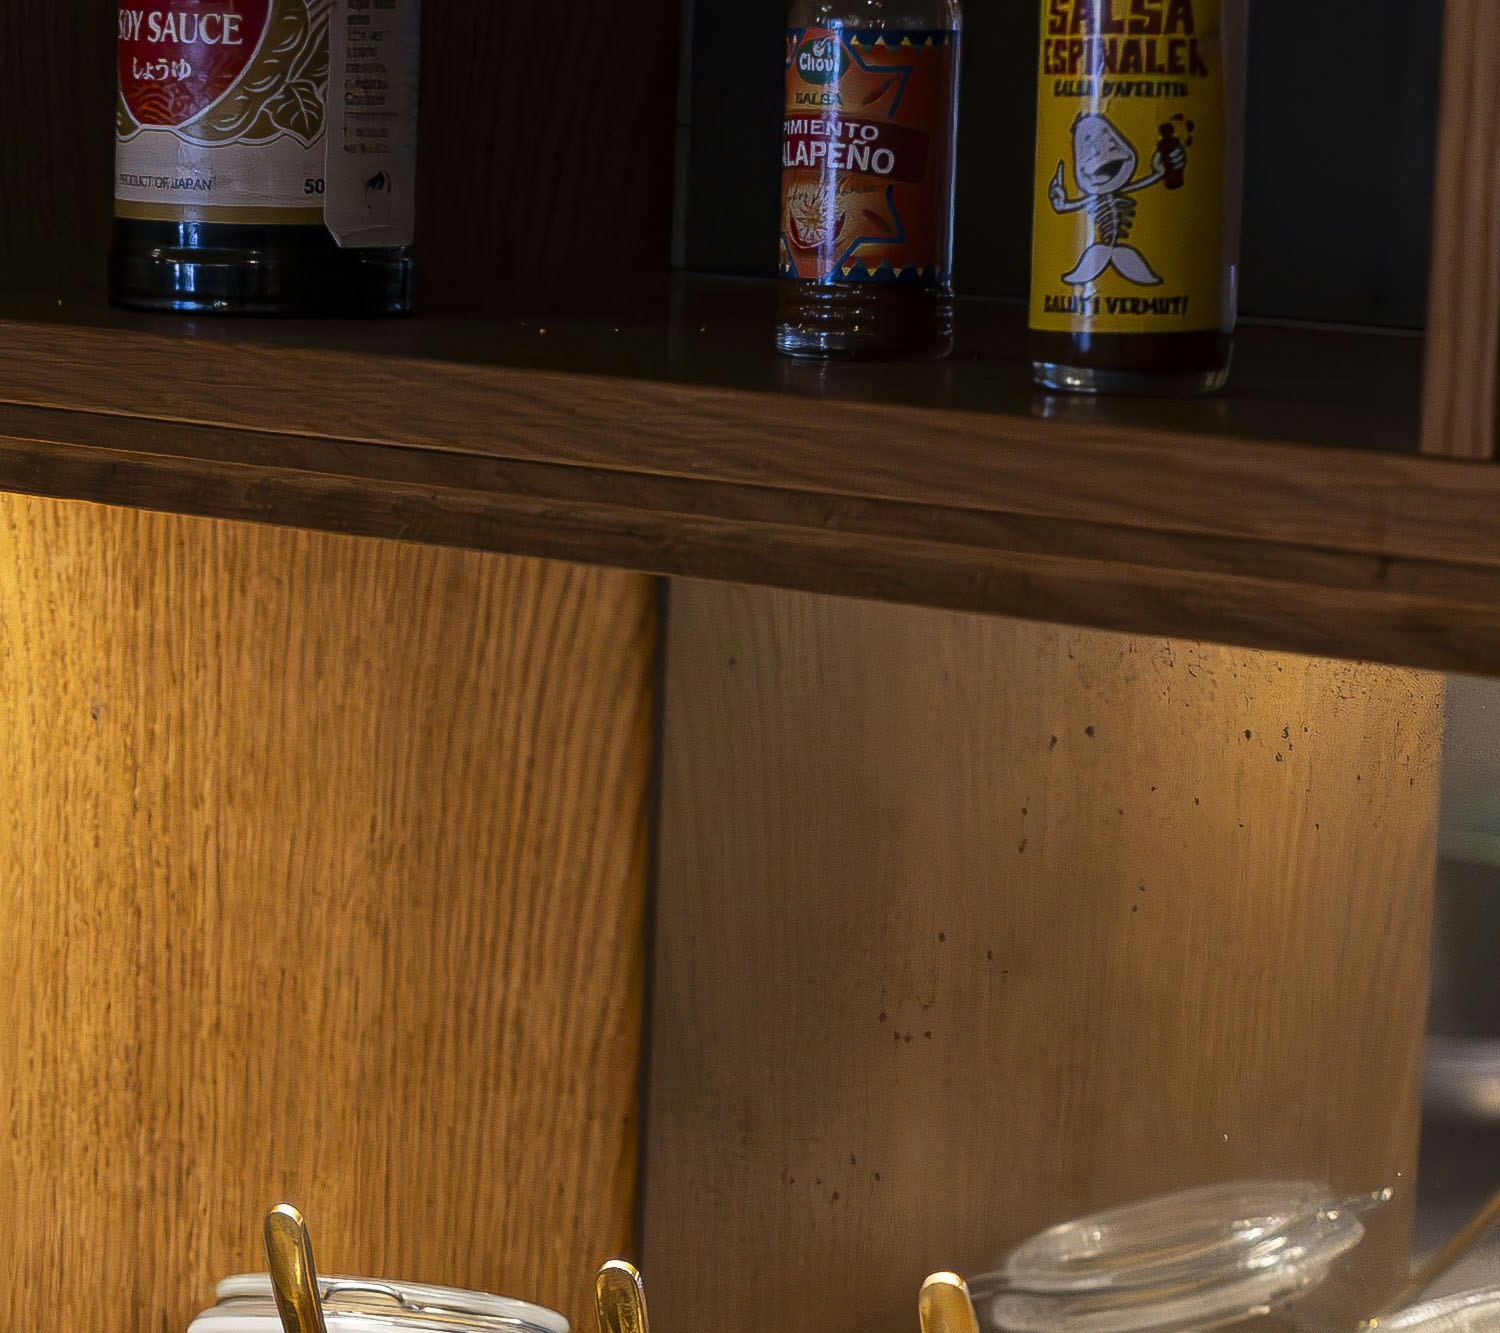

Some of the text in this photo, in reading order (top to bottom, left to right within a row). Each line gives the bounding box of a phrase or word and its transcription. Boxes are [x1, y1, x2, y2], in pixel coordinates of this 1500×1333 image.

[147, 11, 244, 45] SAUCE
[1048, 0, 1195, 35] SALSA
[131, 55, 193, 82] しょうゆ
[799, 51, 838, 72] Chov
[782, 138, 895, 175] LAPEÑO
